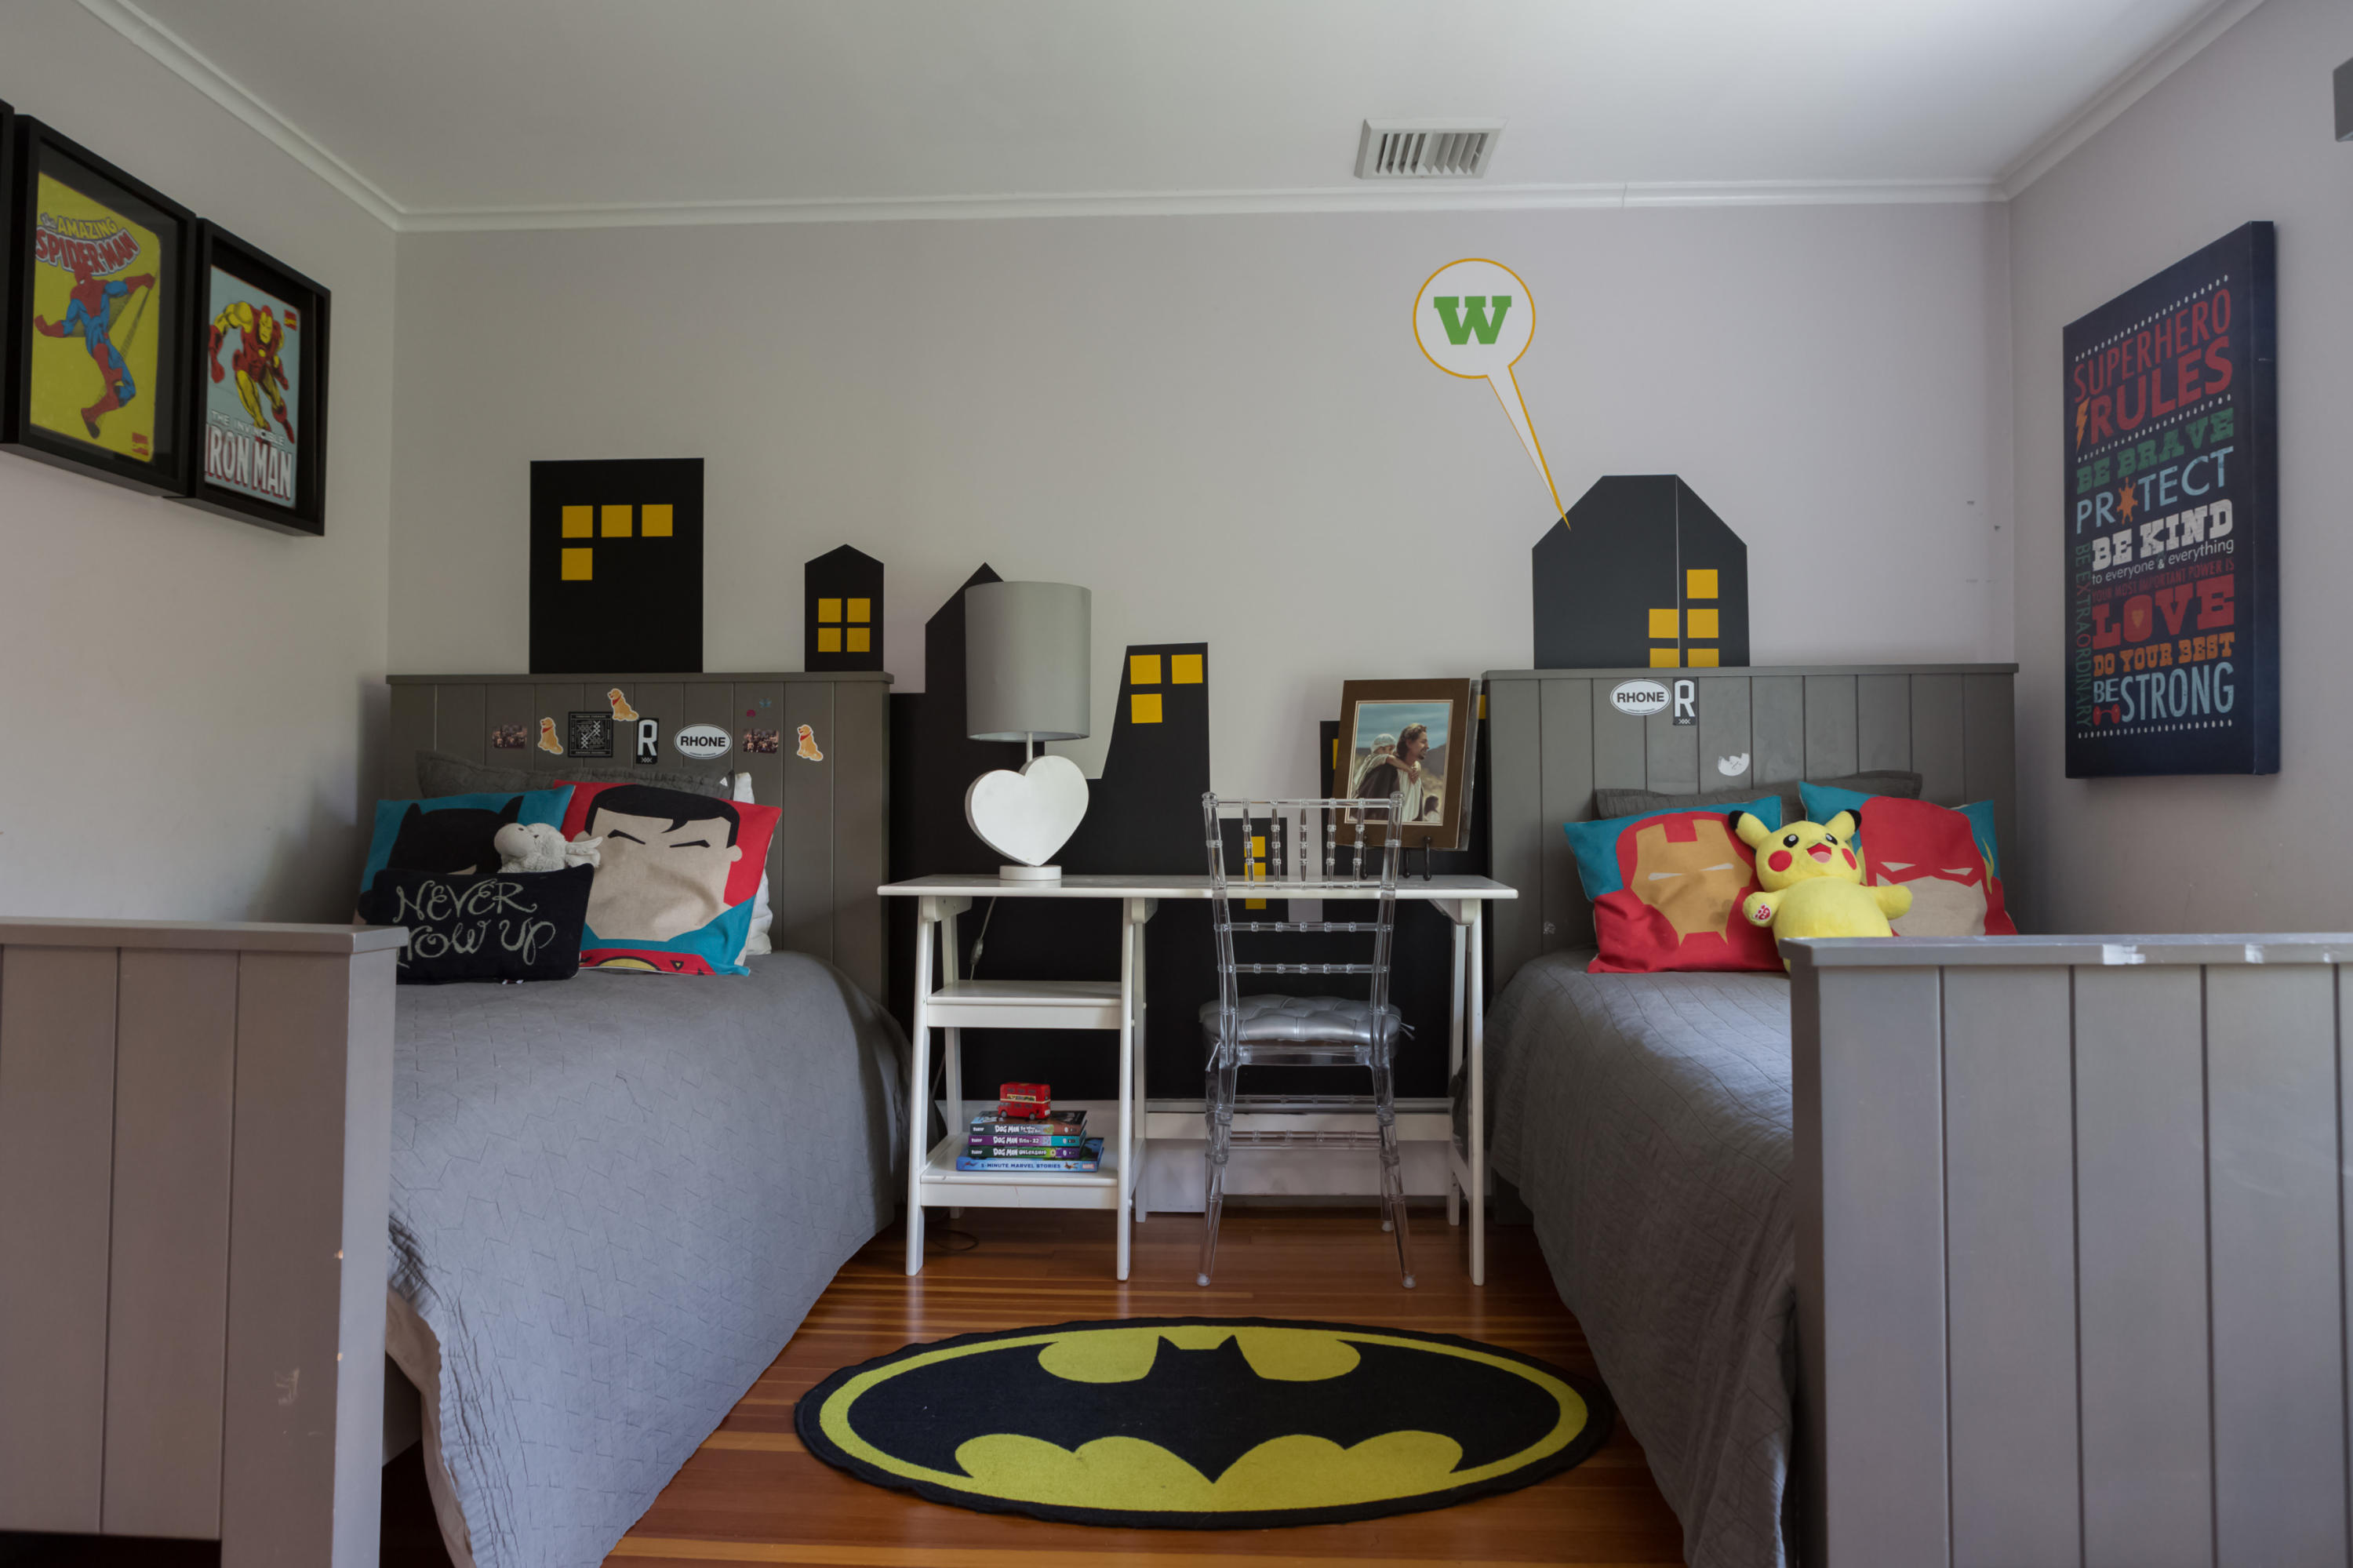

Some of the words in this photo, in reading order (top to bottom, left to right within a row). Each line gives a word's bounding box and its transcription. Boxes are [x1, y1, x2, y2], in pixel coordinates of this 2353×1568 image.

[56, 216, 118, 239] AMAZING
[36, 227, 140, 275] SPIDER-MAN
[1434, 296, 1512, 345] W
[2074, 289, 2231, 402] SUPERHERO
[2090, 336, 2233, 445] RULES
[211, 409, 231, 427] THE
[205, 422, 250, 487] IRON
[252, 441, 293, 500] MAN
[2077, 457, 2111, 495] BE
[2118, 408, 2234, 479] BRAVE
[2092, 528, 2133, 572] BE
[2140, 499, 2233, 558] KIND
[2092, 573, 2102, 585] to
[2105, 559, 2155, 580] everyone
[2157, 558, 2165, 570] &
[2167, 539, 2235, 566] everything
[2188, 559, 2222, 579] POWER
[2092, 573, 2235, 649] LOVE
[2093, 653, 2115, 677] DO
[2119, 642, 2173, 672] YOUR
[2178, 631, 2235, 664] BEST
[1617, 691, 1665, 703] RHONE
[1674, 679, 1696, 718] R
[2093, 678, 2119, 704] BE
[2120, 661, 2235, 722] STRONG
[637, 719, 658, 756] R
[680, 736, 726, 748] RHONE
[393, 879, 537, 923] NEVER
[500, 917, 555, 966] UP
[993, 1136, 1006, 1144] DOG
[1006, 1136, 1018, 1144] MAN
[993, 1148, 1006, 1156] DOG
[1006, 1148, 1018, 1156] MAN
[995, 1125, 1008, 1133] DOG
